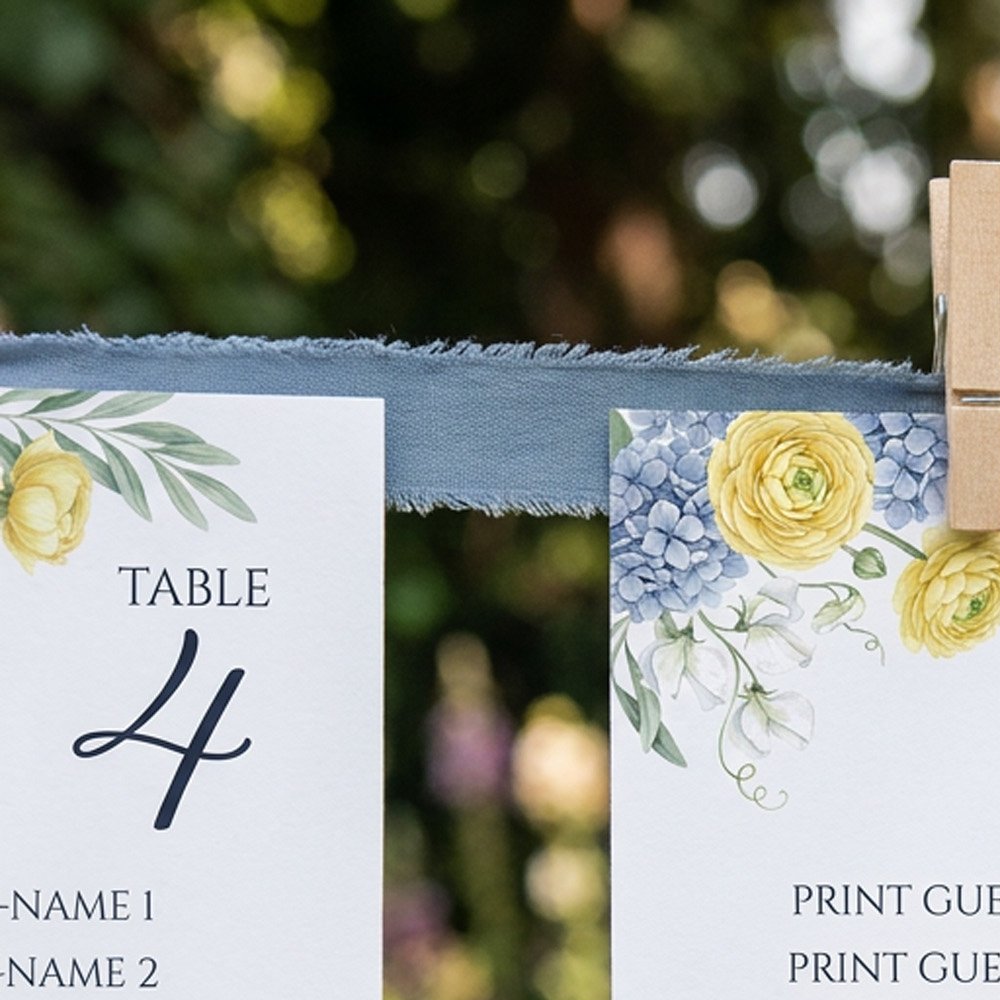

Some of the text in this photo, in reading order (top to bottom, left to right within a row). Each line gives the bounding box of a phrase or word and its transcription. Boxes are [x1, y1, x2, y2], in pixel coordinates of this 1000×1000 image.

[118, 566, 270, 607] TABLE
[72, 628, 252, 831] 4
[0, 889, 152, 921] -NAME 1
[793, 884, 913, 915] PRINT
[139, 956, 159, 988] 2
[789, 952, 908, 983] PRINT
